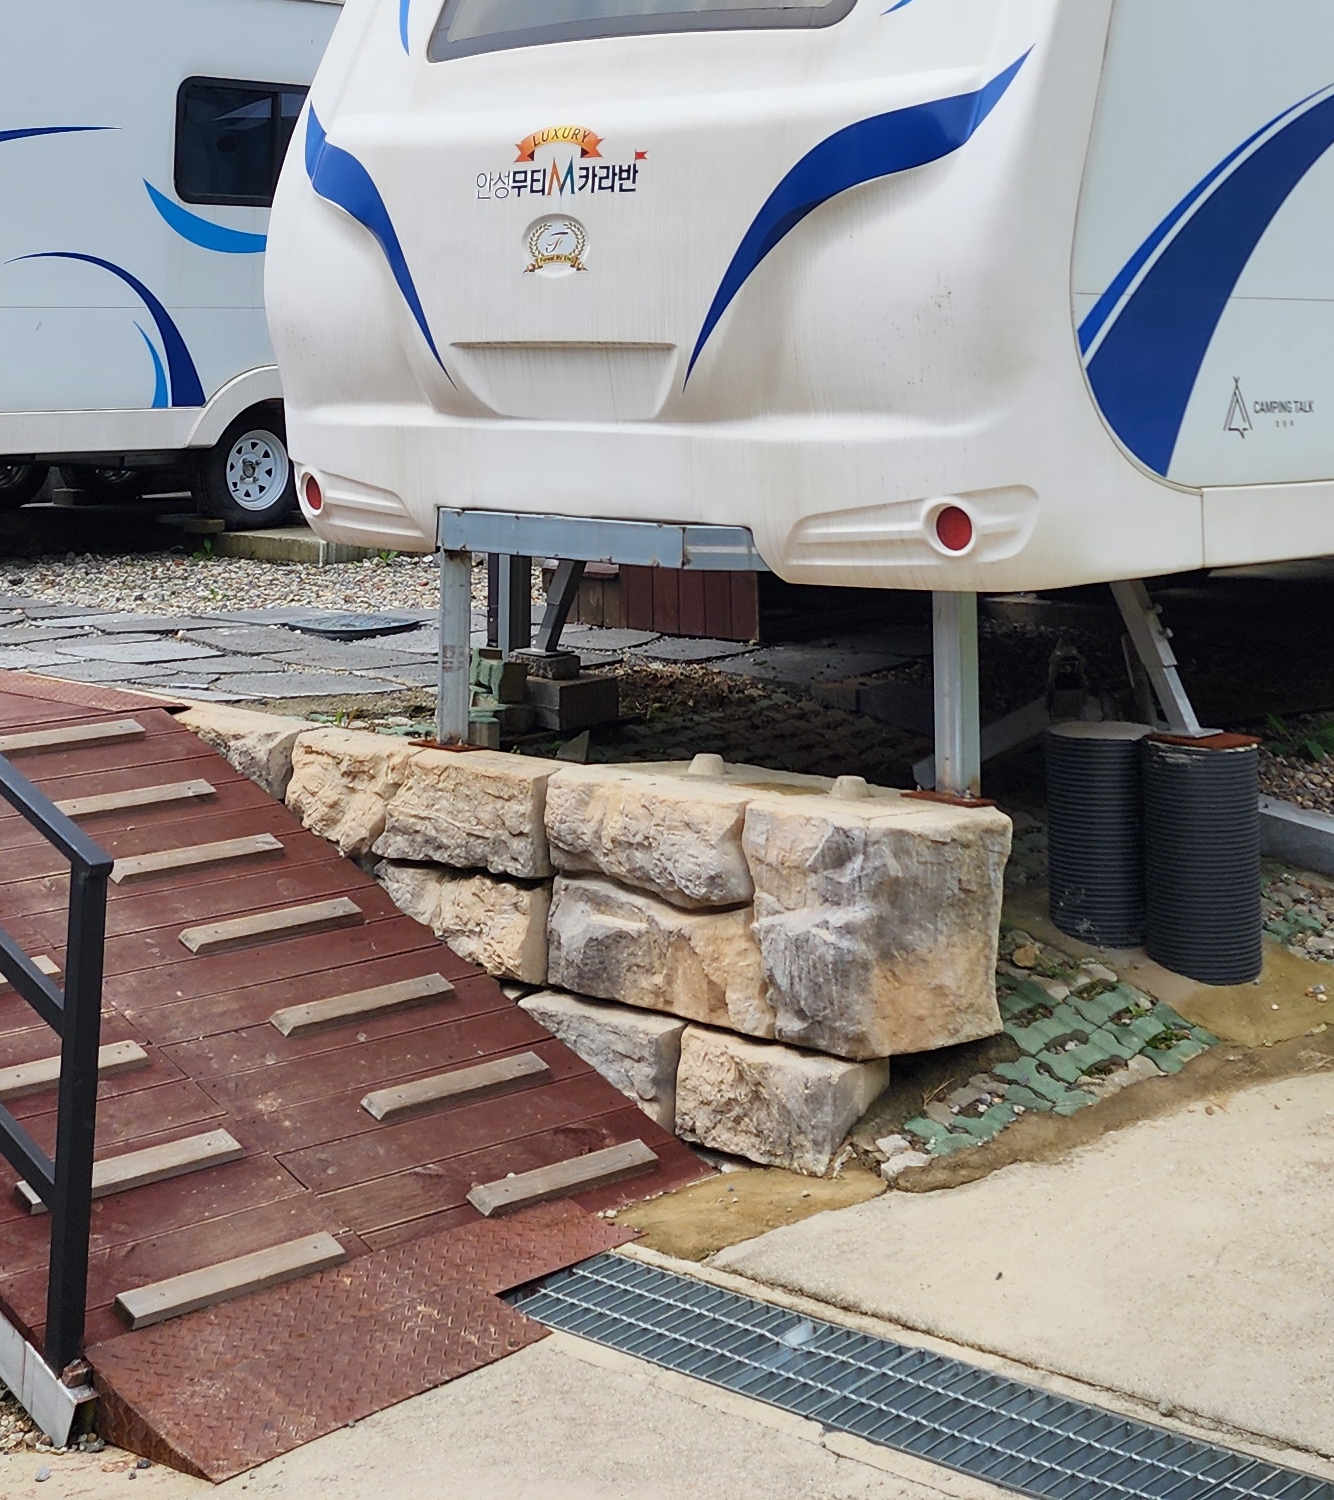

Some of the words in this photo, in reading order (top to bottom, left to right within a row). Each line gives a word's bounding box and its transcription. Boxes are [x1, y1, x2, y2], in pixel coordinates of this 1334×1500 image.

[532, 127, 590, 147] LUXURY
[1253, 400, 1293, 414] CAMPING
[1293, 400, 1315, 413] TALK
